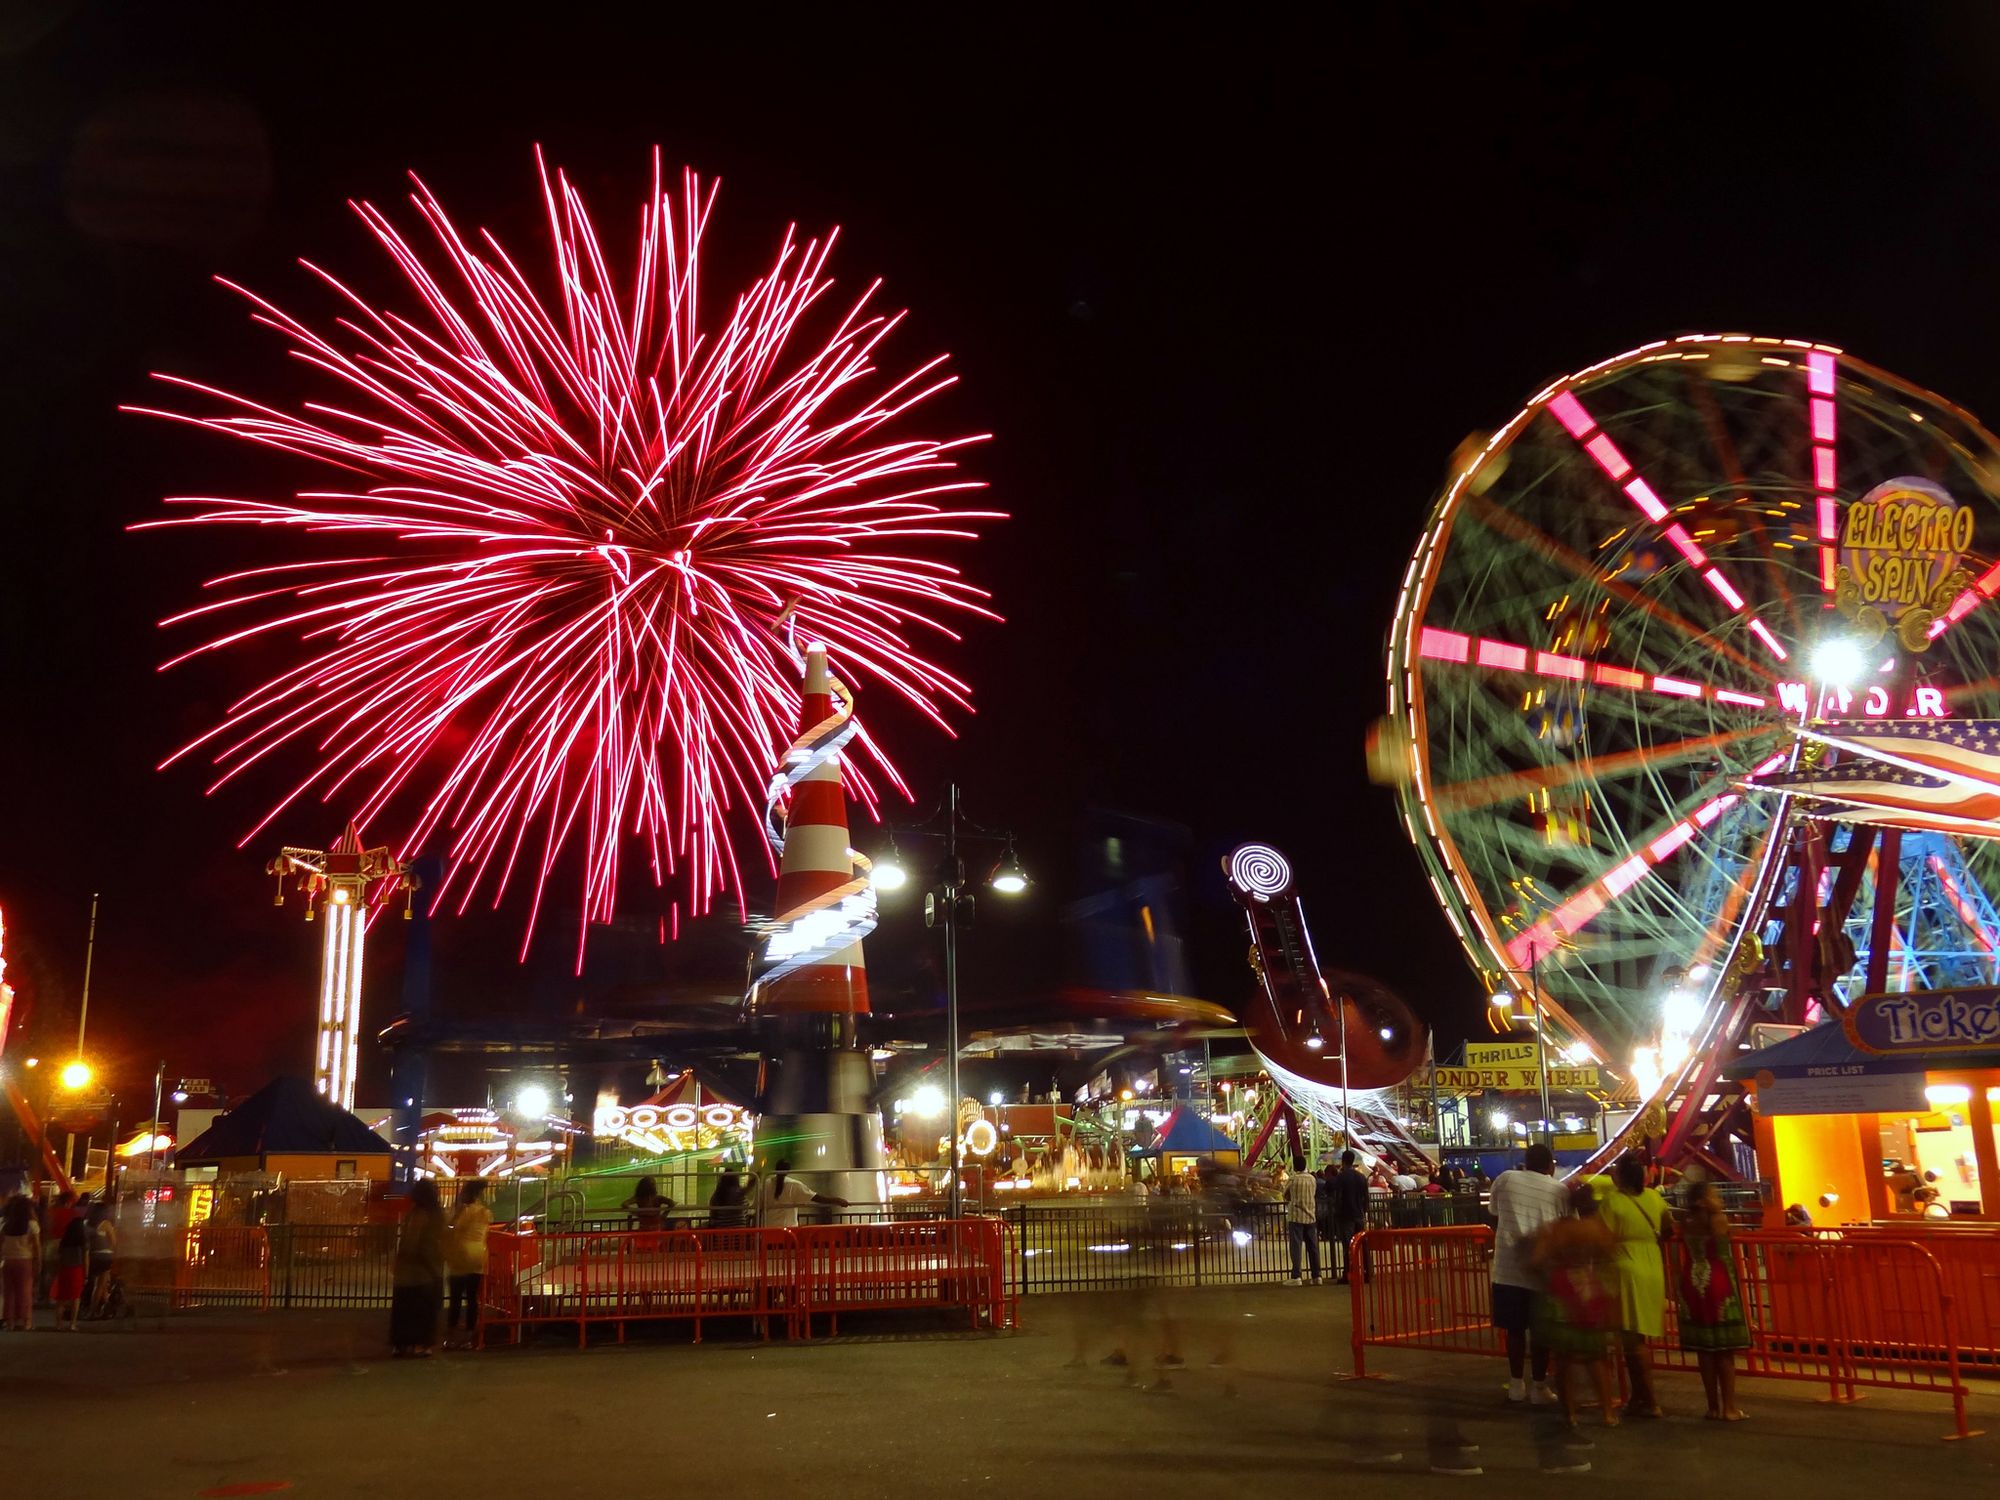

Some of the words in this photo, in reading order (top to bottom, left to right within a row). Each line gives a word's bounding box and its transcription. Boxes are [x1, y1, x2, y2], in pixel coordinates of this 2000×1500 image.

[1843, 501, 1975, 553] ELECTRO
[1863, 555, 1934, 605] SPIN
[1875, 995, 2000, 1043] Ticke
[1468, 1045, 1533, 1065] THRILLS
[1807, 1066, 1839, 1077] PRICE
[1841, 1065, 1865, 1075] LIST
[1418, 1069, 1510, 1087] ONDER
